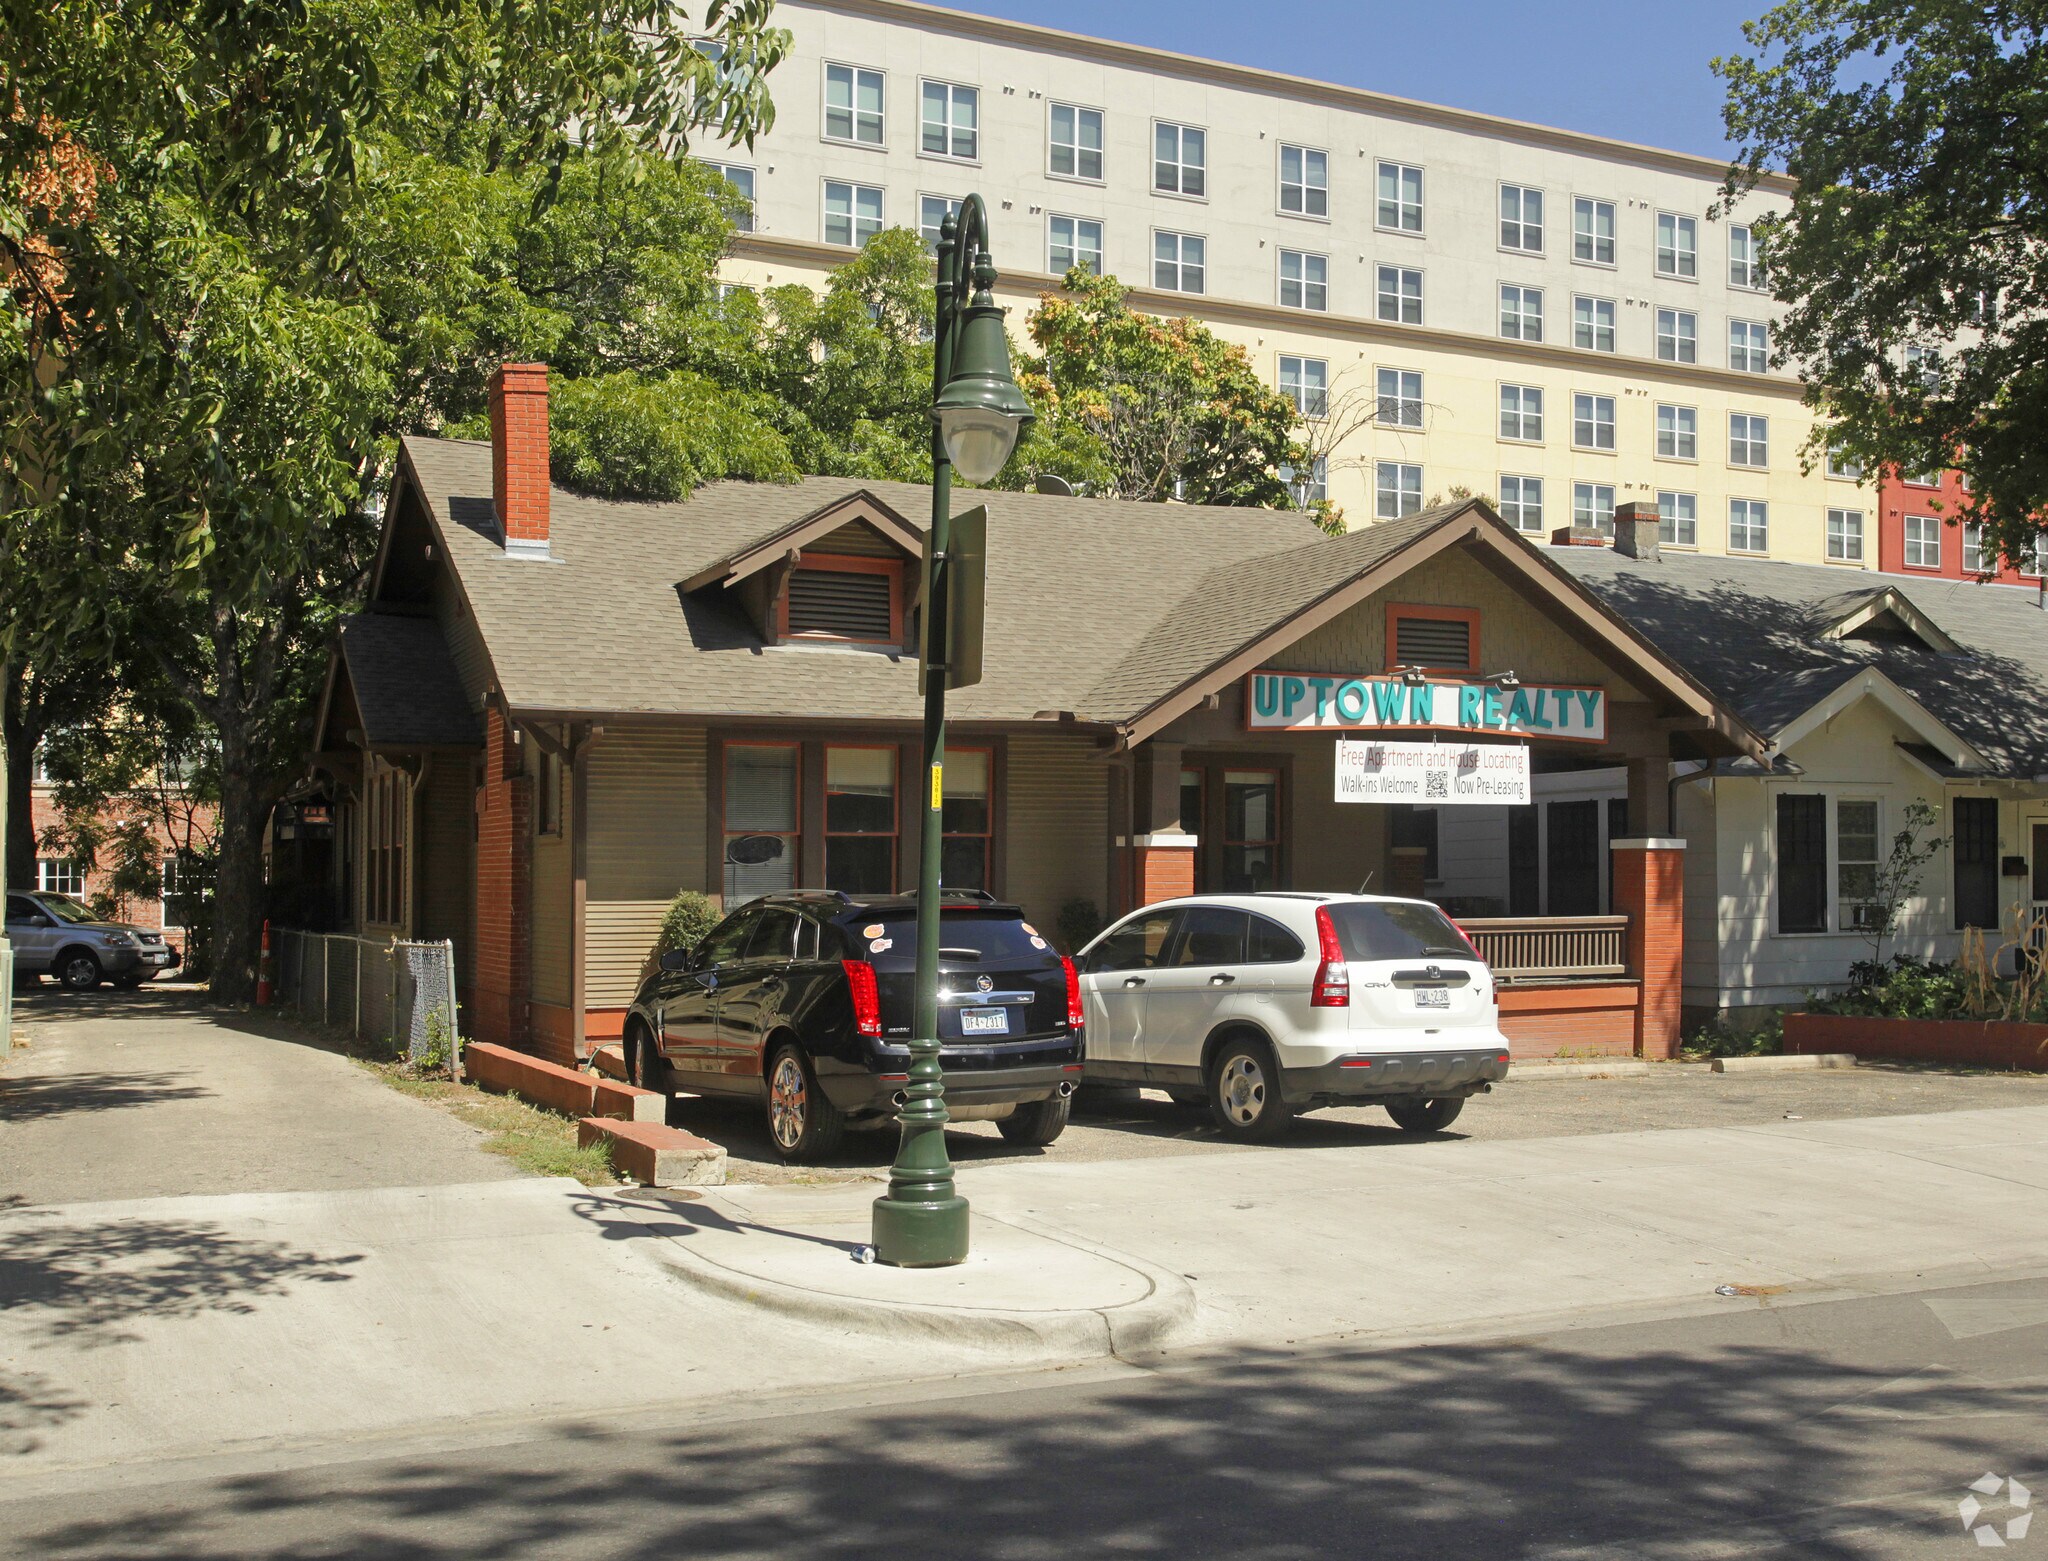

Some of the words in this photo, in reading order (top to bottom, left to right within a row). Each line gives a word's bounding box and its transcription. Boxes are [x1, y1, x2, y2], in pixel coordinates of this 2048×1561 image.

[1255, 676, 1434, 721] UPTOWN
[1459, 685, 1602, 730] REALTY
[1341, 746, 1364, 766] Free
[1367, 747, 1423, 771] Apartment
[1426, 749, 1446, 768] and
[1449, 749, 1480, 768] House
[1483, 750, 1524, 774] Locating
[1341, 775, 1378, 793] Walk-ins
[1379, 775, 1419, 794] Welcome
[1453, 777, 1475, 794] Now
[1476, 777, 1524, 799] Pre-Leasing
